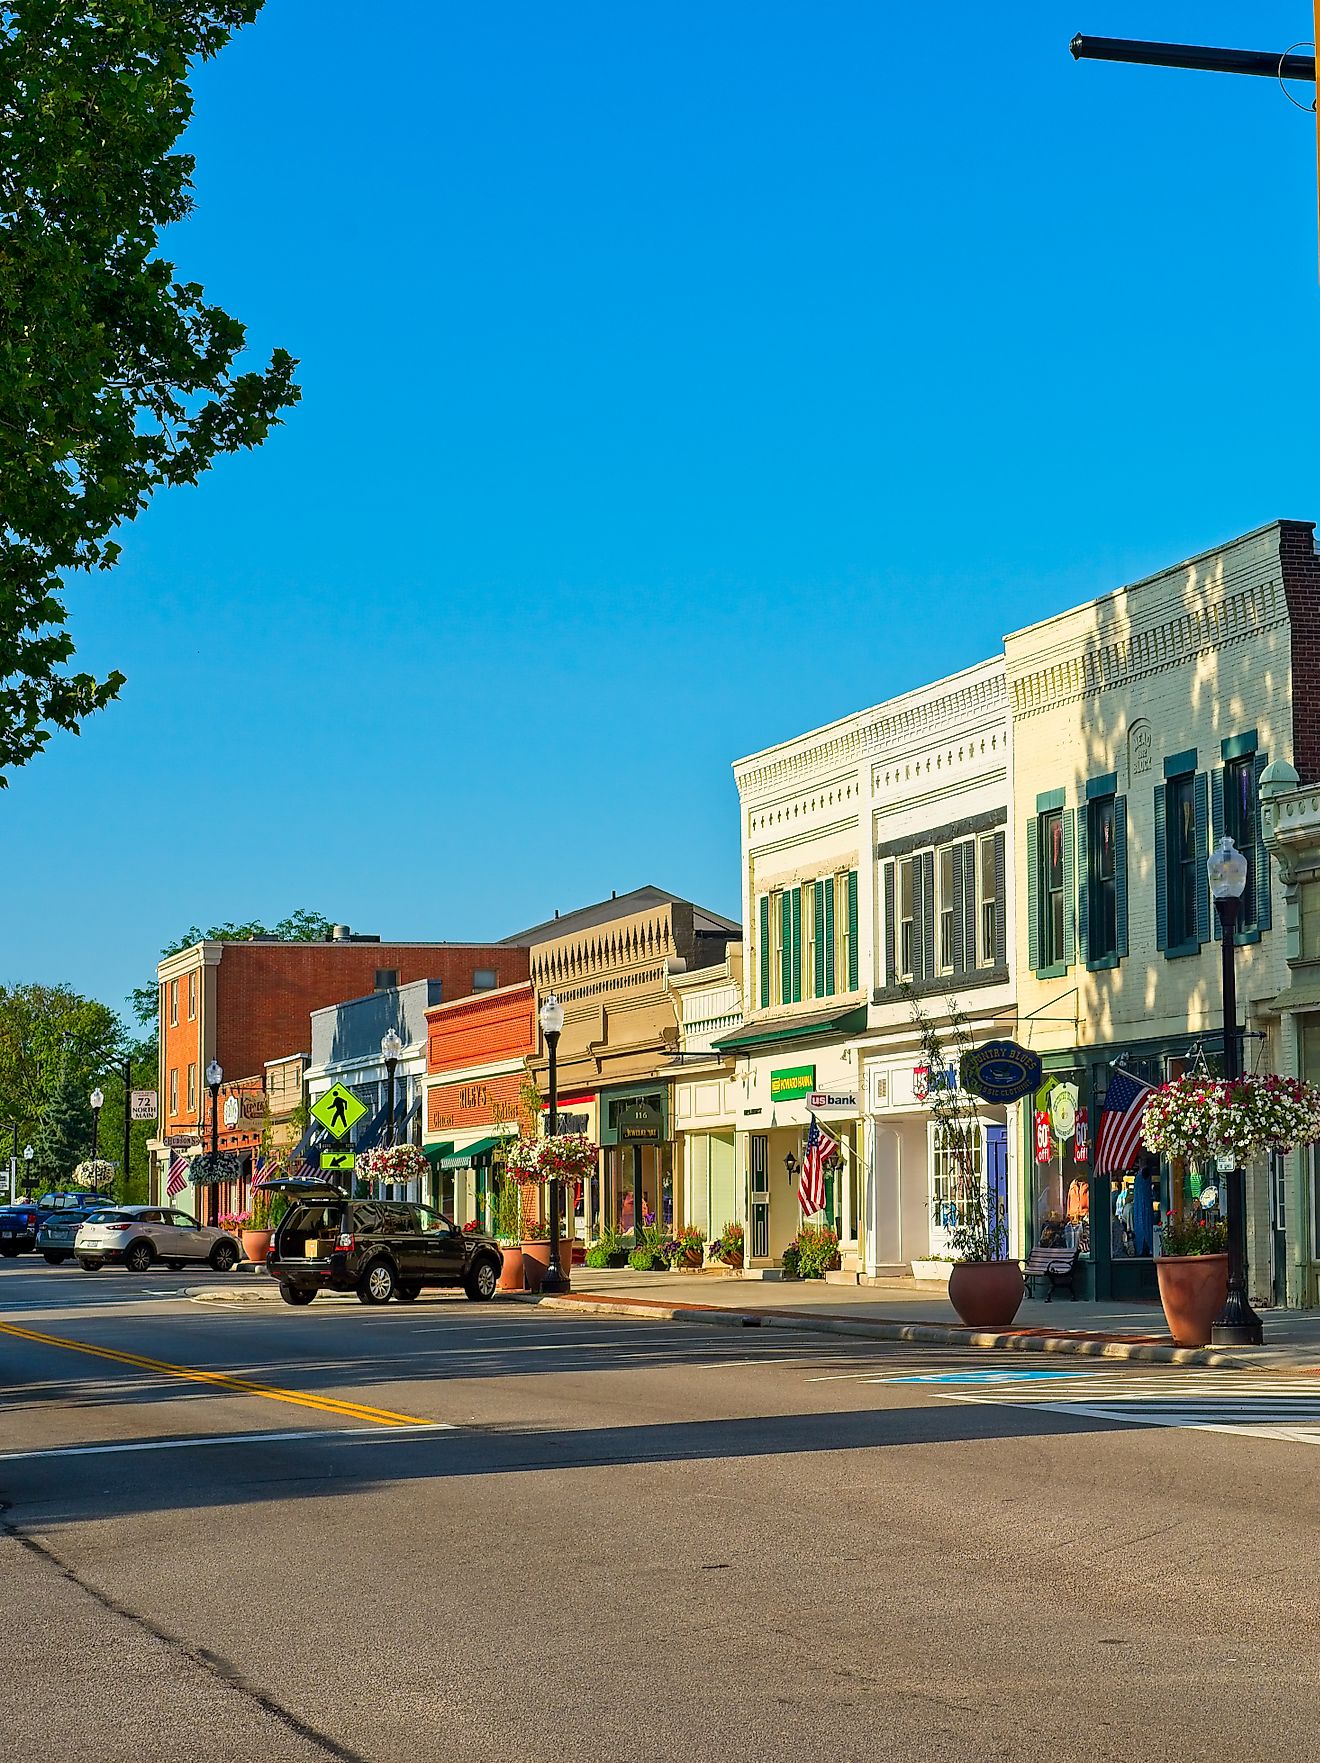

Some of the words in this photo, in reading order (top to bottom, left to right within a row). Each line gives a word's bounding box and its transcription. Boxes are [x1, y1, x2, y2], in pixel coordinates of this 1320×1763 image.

[1008, 1049, 1038, 1070] BLUES
[137, 1097, 151, 1107] 72
[635, 1111, 648, 1119] 116
